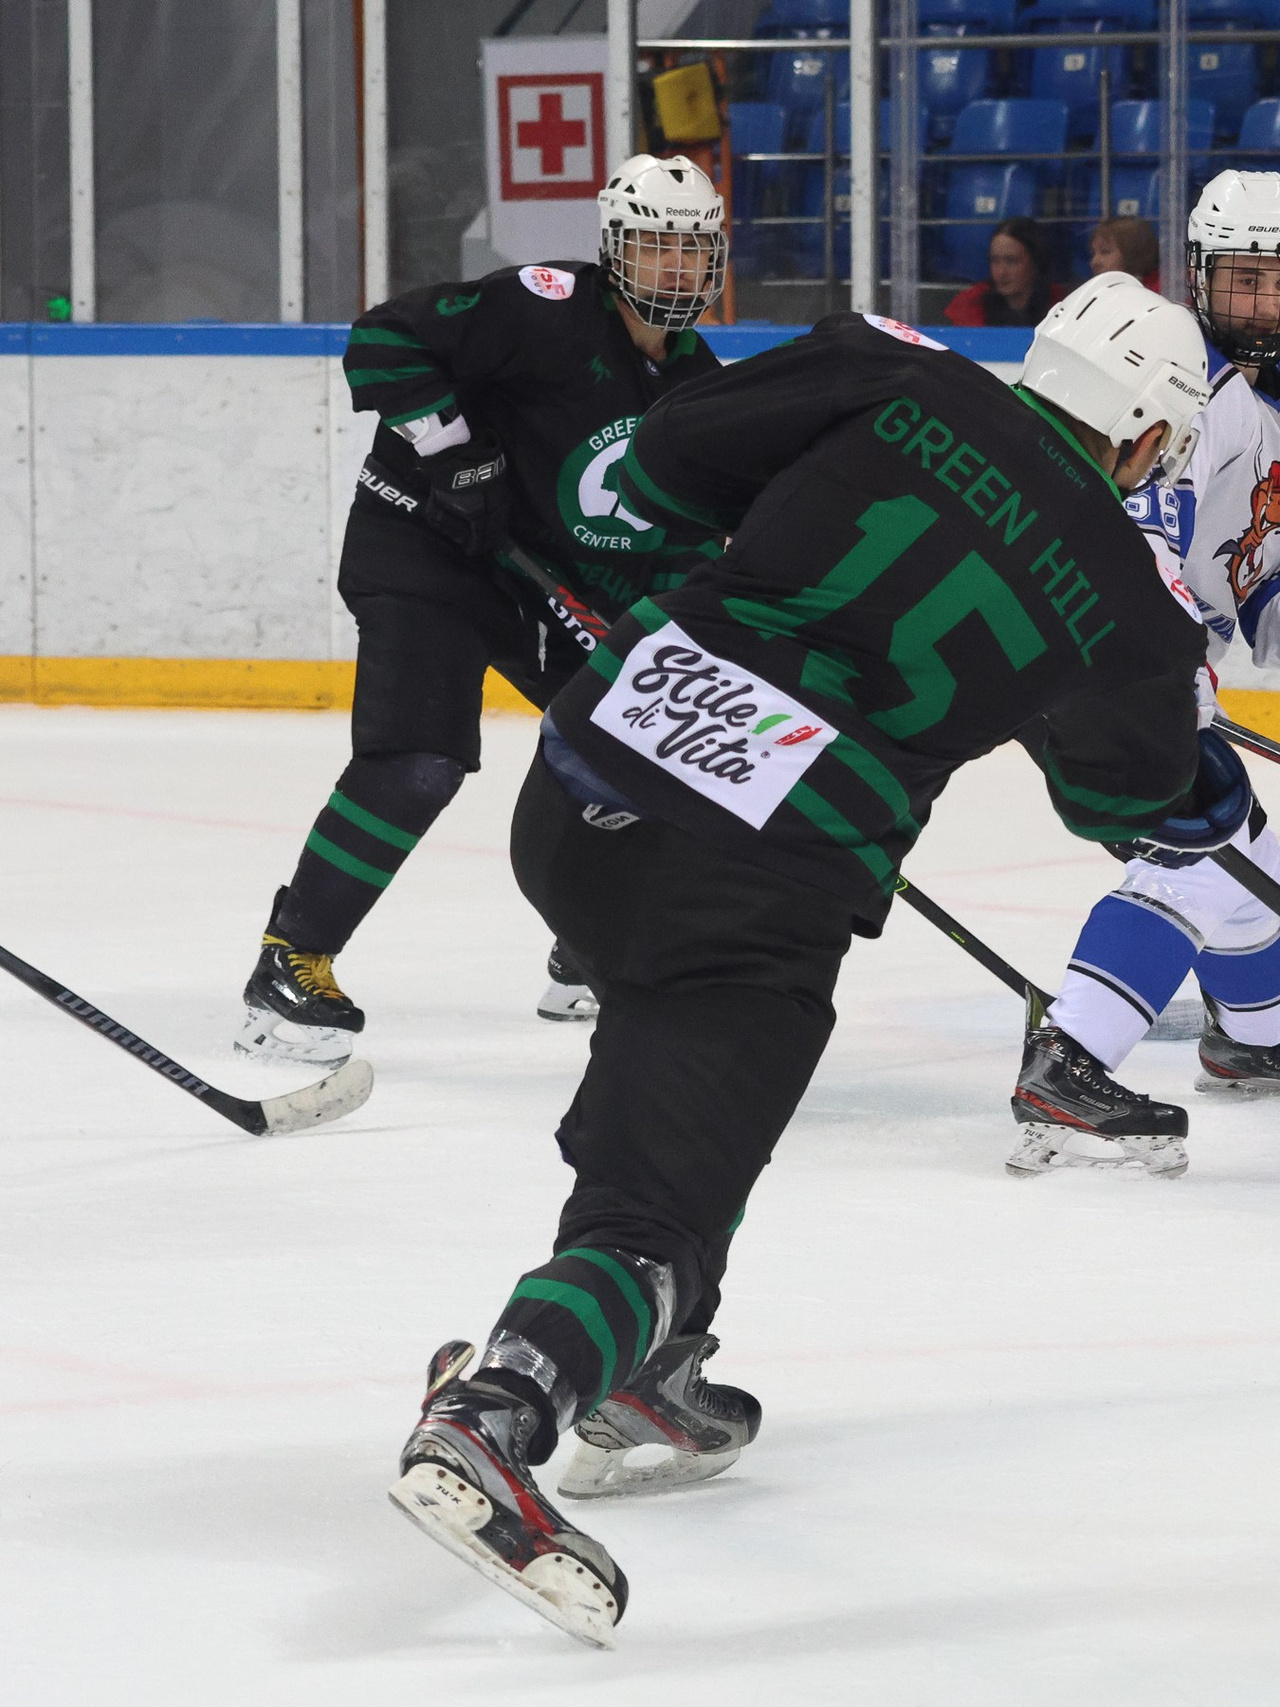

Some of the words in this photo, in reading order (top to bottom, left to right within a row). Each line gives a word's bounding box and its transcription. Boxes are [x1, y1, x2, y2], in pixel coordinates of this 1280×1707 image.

[665, 207, 701, 217] Reebok
[1168, 375, 1201, 399] BAUER
[589, 416, 641, 451] GREE
[357, 467, 419, 512] AUER
[1038, 436, 1088, 490] LUTCH
[573, 524, 632, 550] CENTER
[873, 396, 1039, 546] GREEN
[1028, 537, 1116, 667] HILL
[721, 494, 1048, 741] 15
[632, 644, 758, 728] Stile
[622, 697, 664, 730] di
[655, 705, 756, 785] Vita
[56, 990, 210, 1096] WARRIOR
